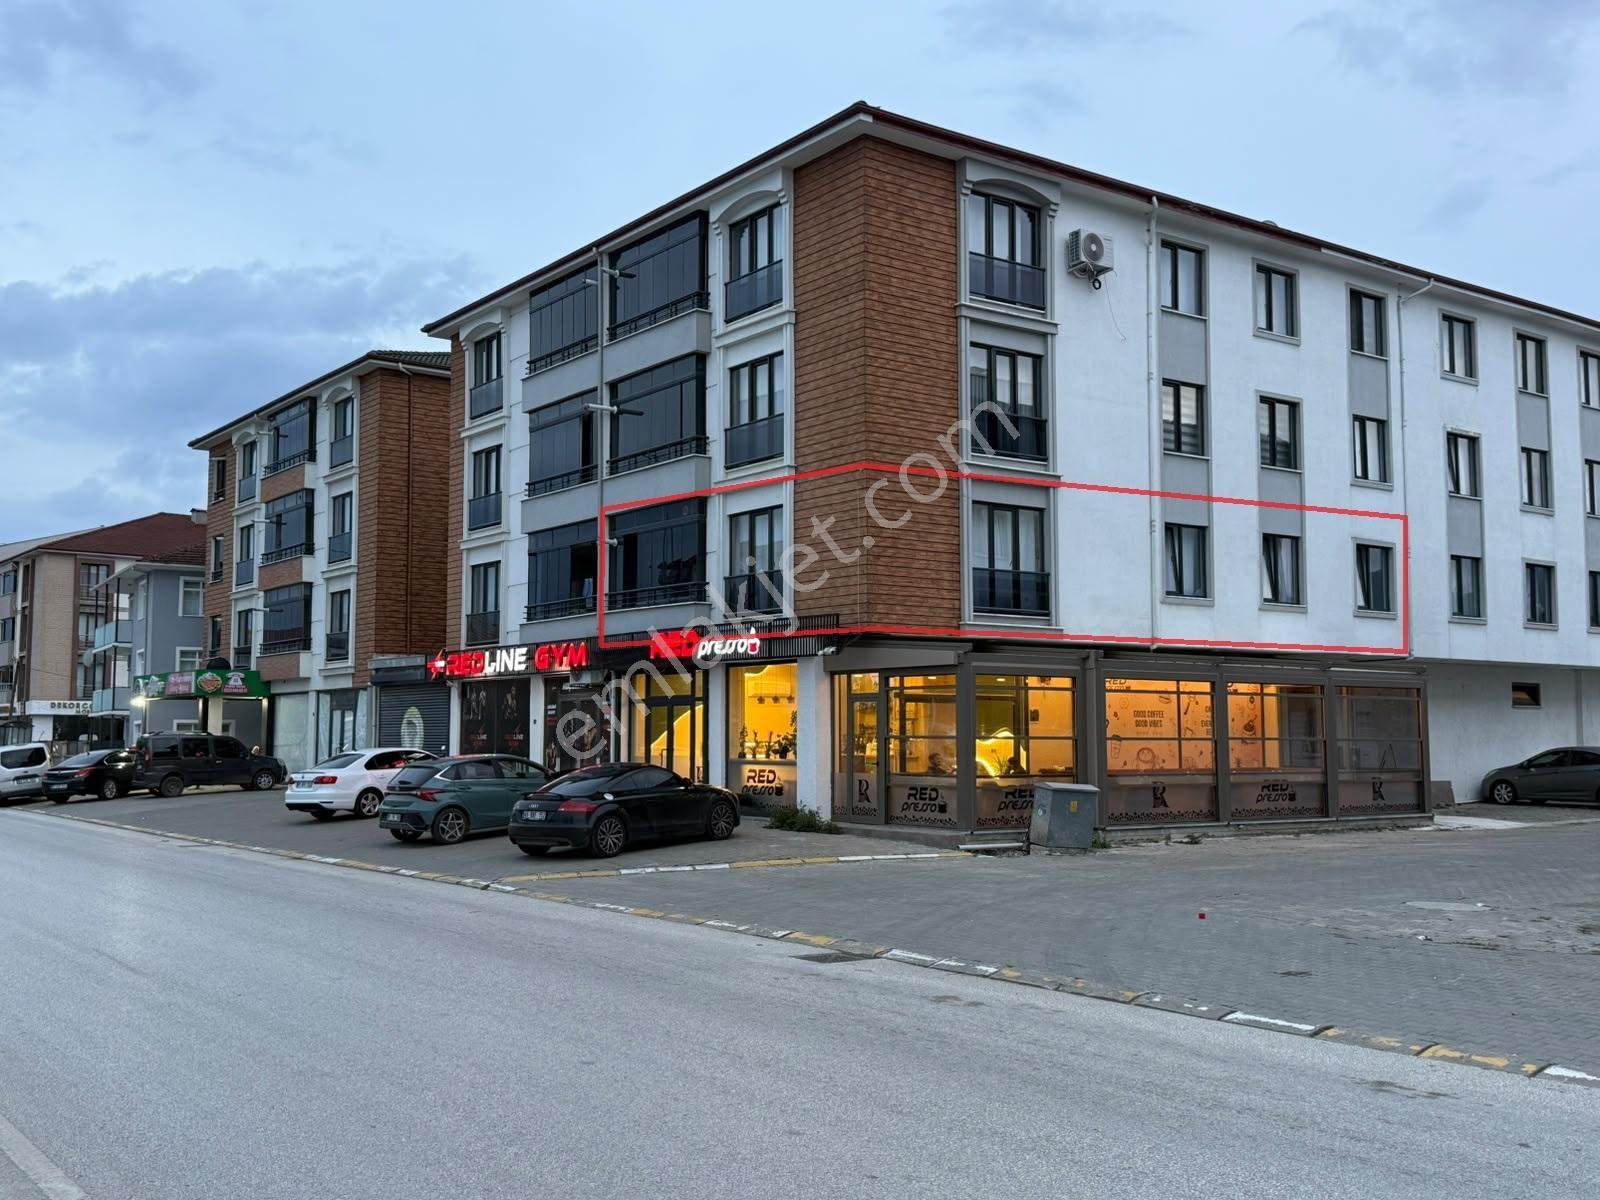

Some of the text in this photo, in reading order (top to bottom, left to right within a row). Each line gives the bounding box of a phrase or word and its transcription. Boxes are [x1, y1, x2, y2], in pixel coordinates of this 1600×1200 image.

[535, 641, 588, 671] GYM
[1147, 710, 1165, 718] COFFEE
[746, 769, 777, 784] RED
[907, 786, 939, 801] RED
[1256, 793, 1288, 804] presso
[901, 801, 937, 813] presso
